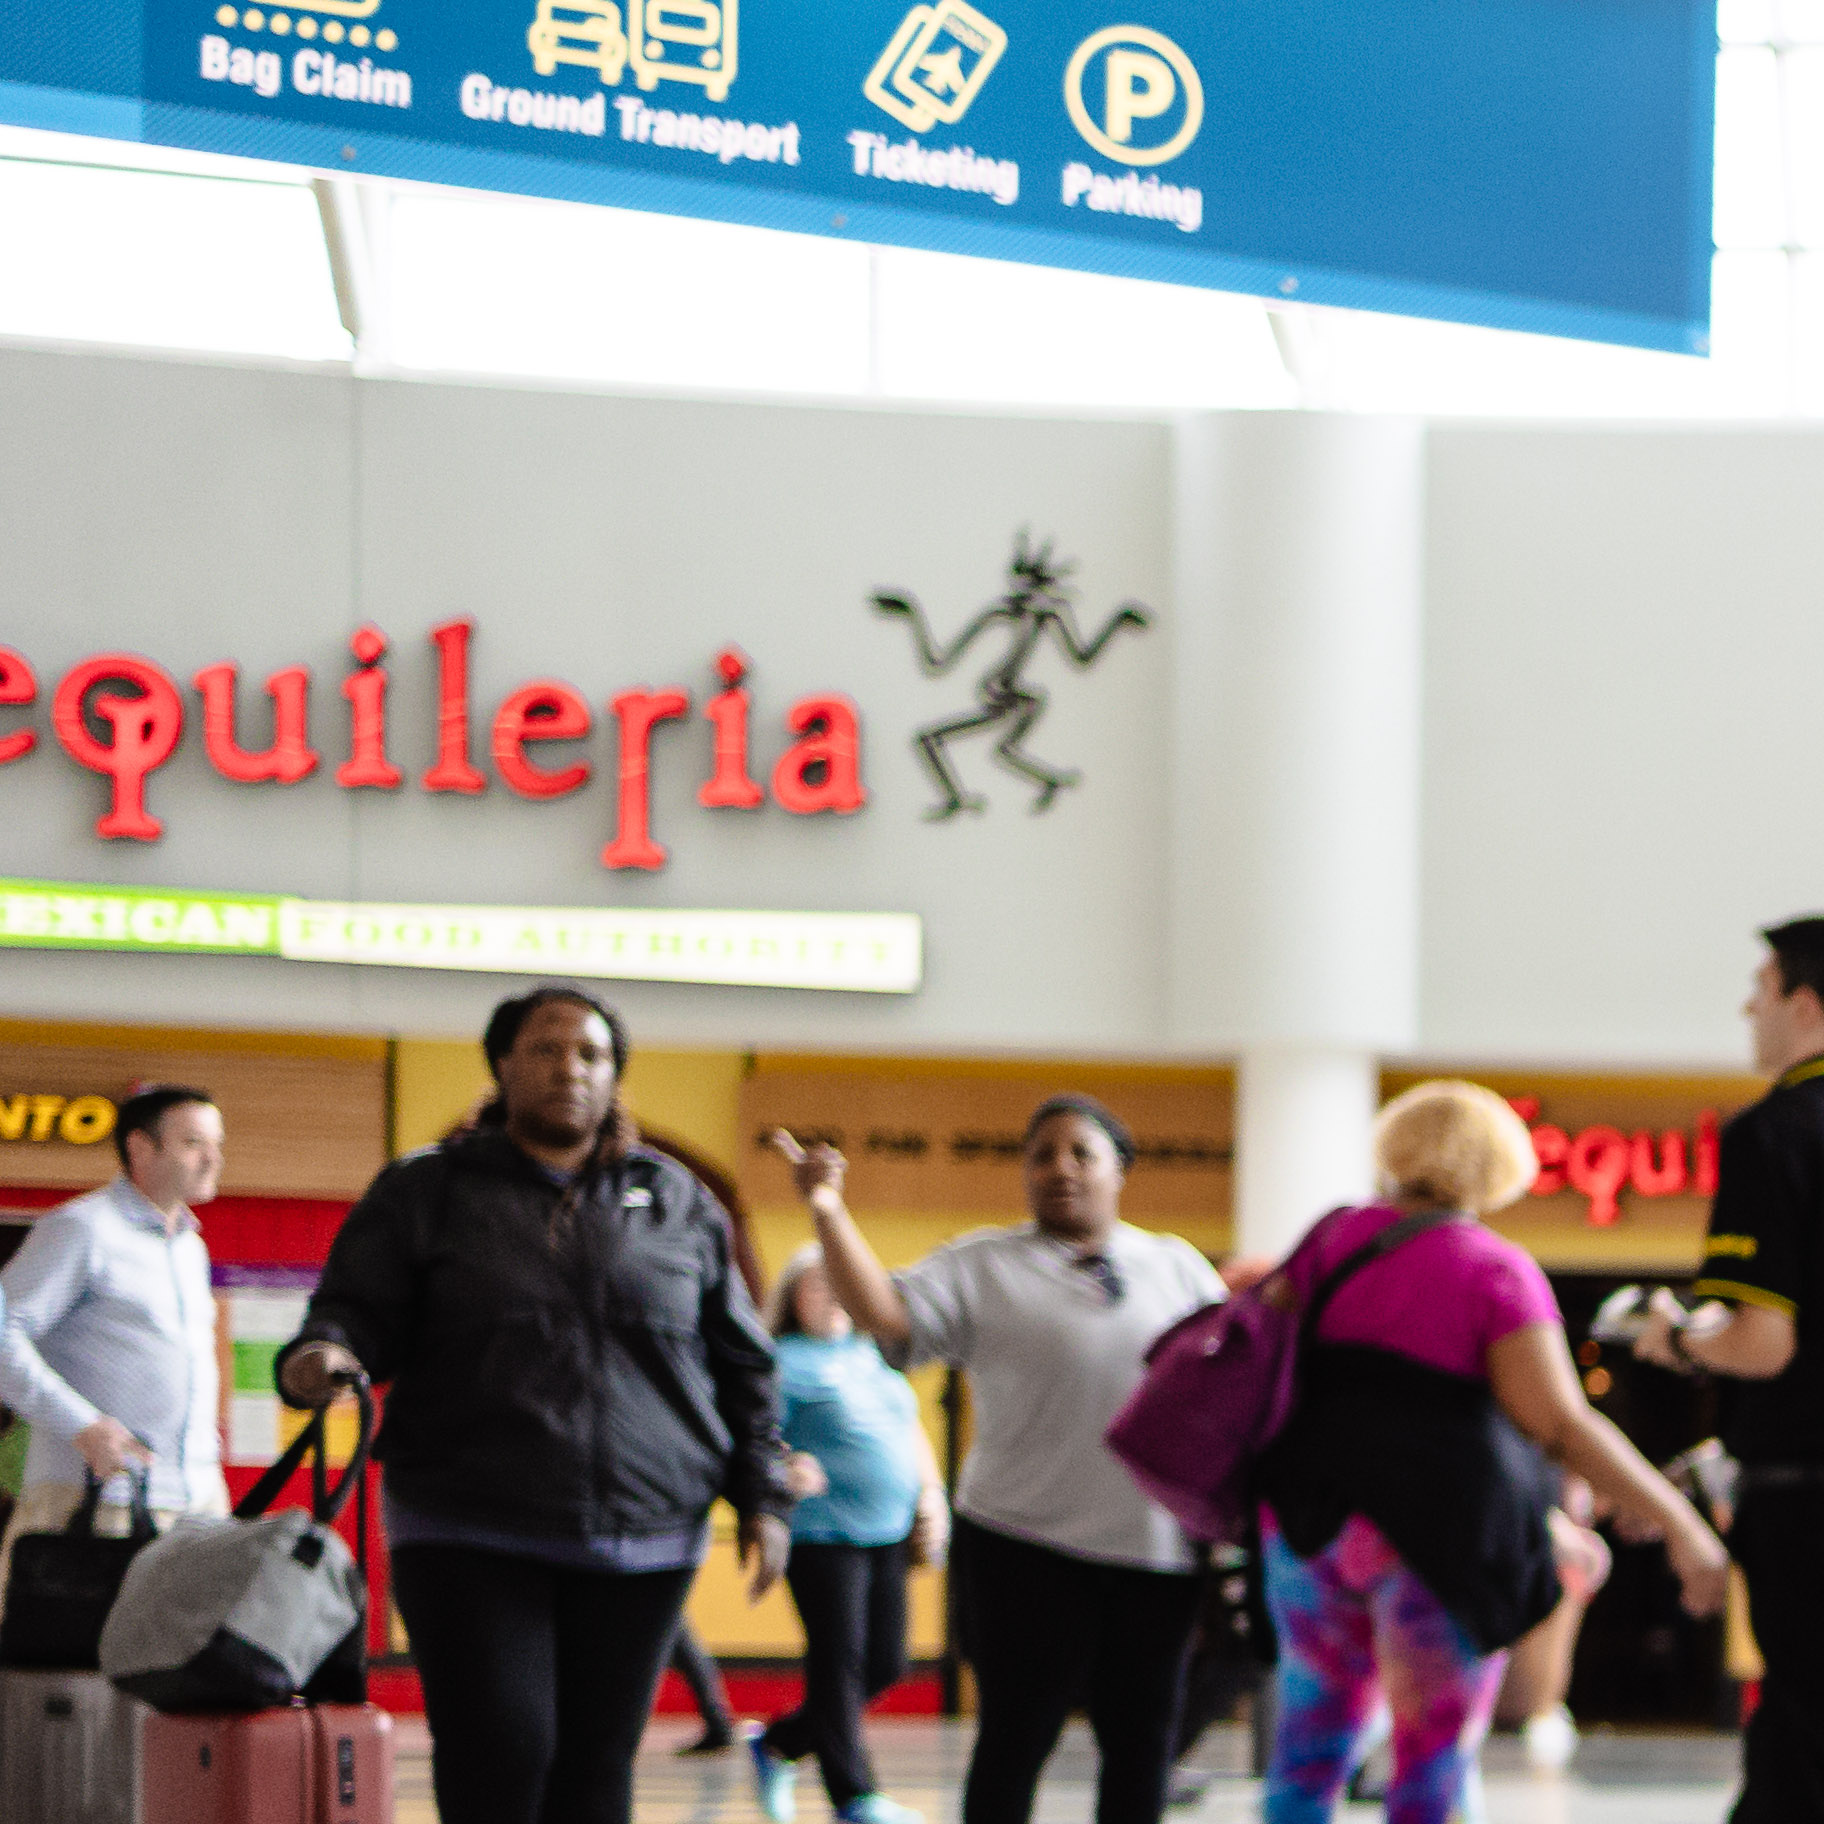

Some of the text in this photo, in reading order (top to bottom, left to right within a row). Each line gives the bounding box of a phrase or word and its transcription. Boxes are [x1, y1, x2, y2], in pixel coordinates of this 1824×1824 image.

[200, 34, 412, 109] Bag Claim
[1105, 49, 1176, 143] P
[460, 72, 801, 166] Ground Transport
[846, 129, 1019, 205] Ticketing
[1062, 161, 1203, 232] Parking
[301, 915, 484, 953] FOOD
[512, 916, 897, 966] AUTHORITY
